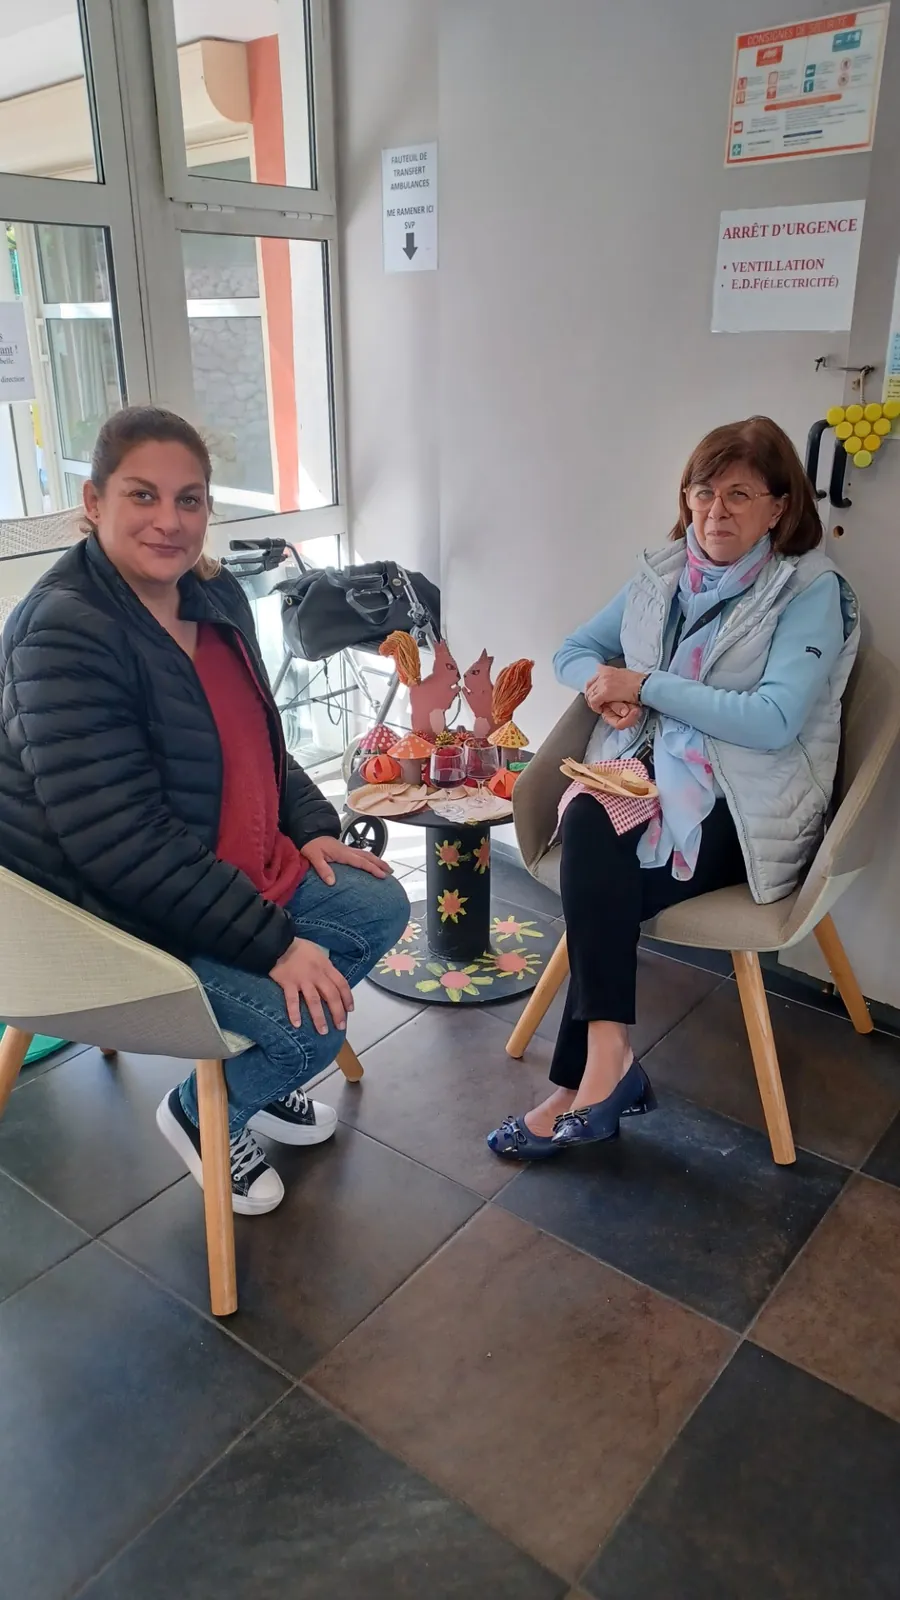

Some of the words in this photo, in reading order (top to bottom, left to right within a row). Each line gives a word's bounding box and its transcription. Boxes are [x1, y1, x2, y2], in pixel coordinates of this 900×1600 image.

[747, 29, 793, 45] CONSIGNES
[391, 154, 418, 164] FAUTEUIL
[419, 152, 428, 161] DE
[393, 165, 426, 177] TRANSFERT
[390, 179, 430, 190] AMBULANCES
[386, 209, 396, 217] ME
[397, 206, 425, 216] RAMENER
[426, 205, 434, 214] ICI
[404, 221, 416, 230] SVP
[722, 222, 769, 240] ARRÊT
[771, 218, 858, 237] D'URGENCE
[731, 258, 825, 273] VENTILLATION
